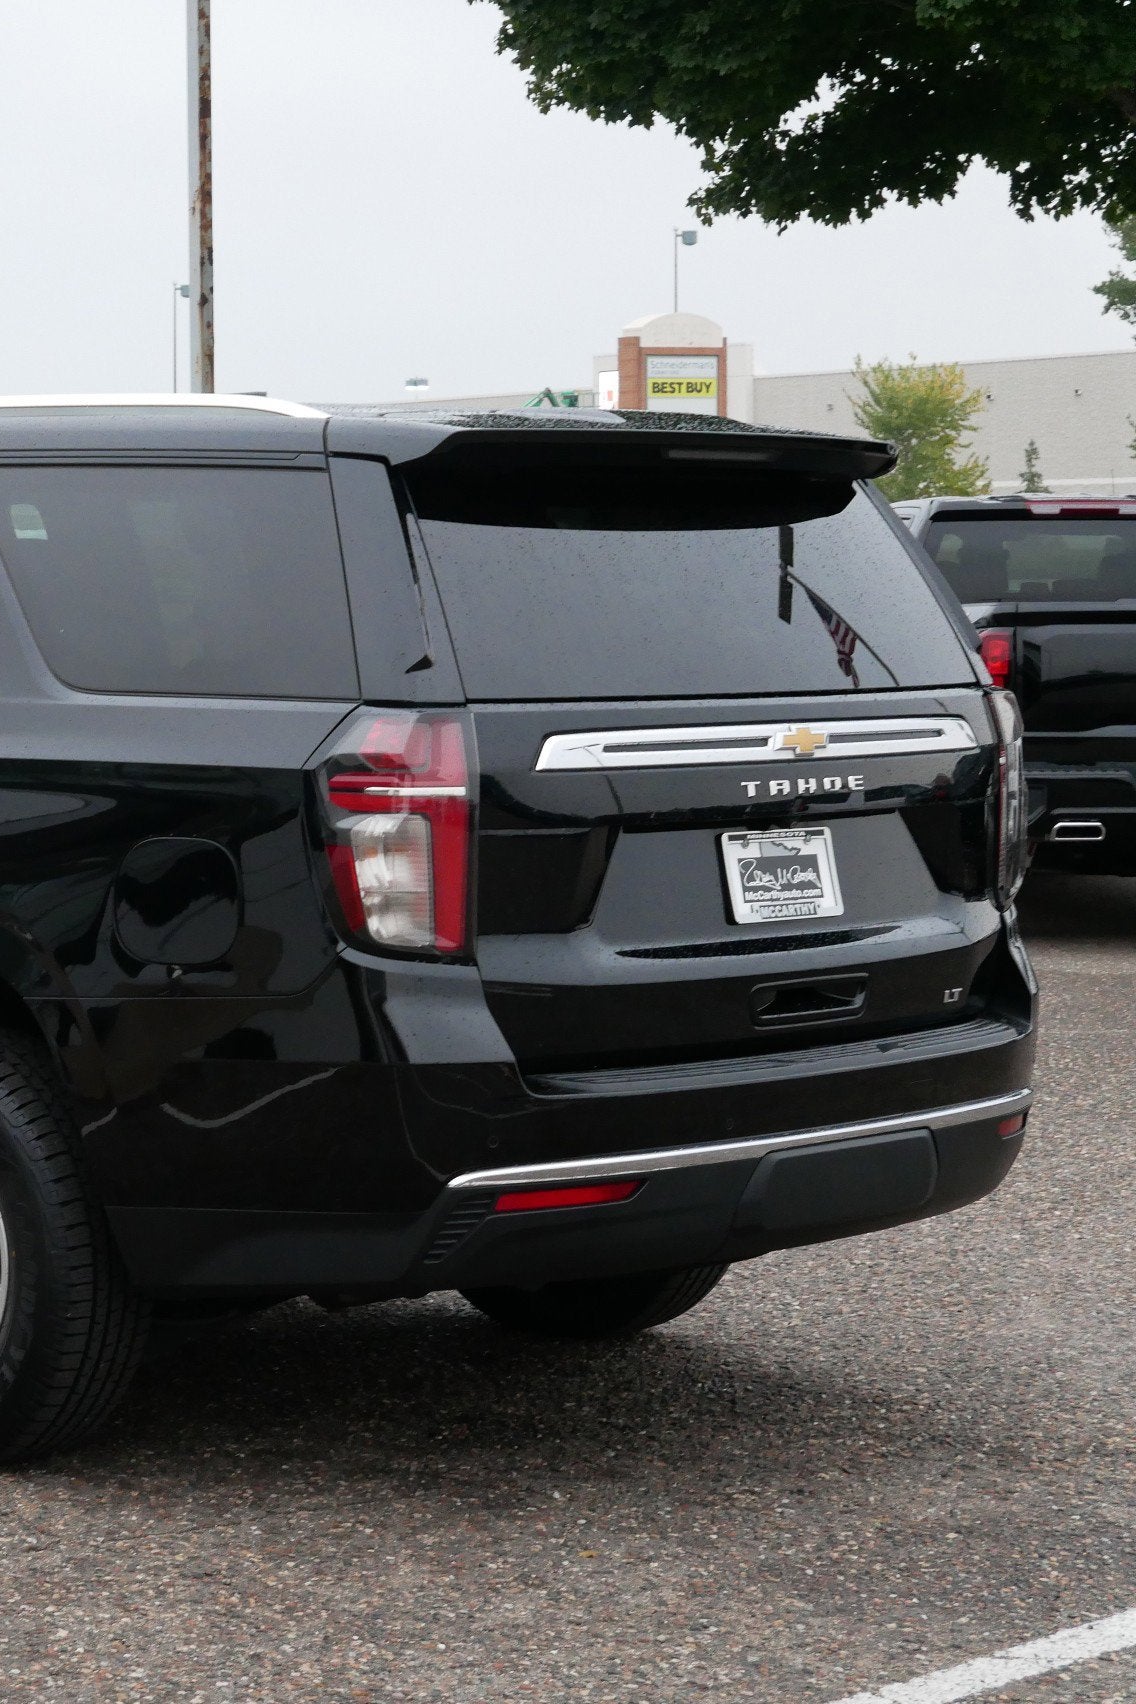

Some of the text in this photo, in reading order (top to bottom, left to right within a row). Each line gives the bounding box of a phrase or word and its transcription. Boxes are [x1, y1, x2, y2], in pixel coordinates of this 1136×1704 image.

[651, 381, 712, 394] BEST BUY
[740, 775, 864, 798] TAHOE
[746, 831, 807, 840] MINNESOTA
[744, 888, 823, 902] McCarthyauto.com
[943, 987, 963, 1003] LT
